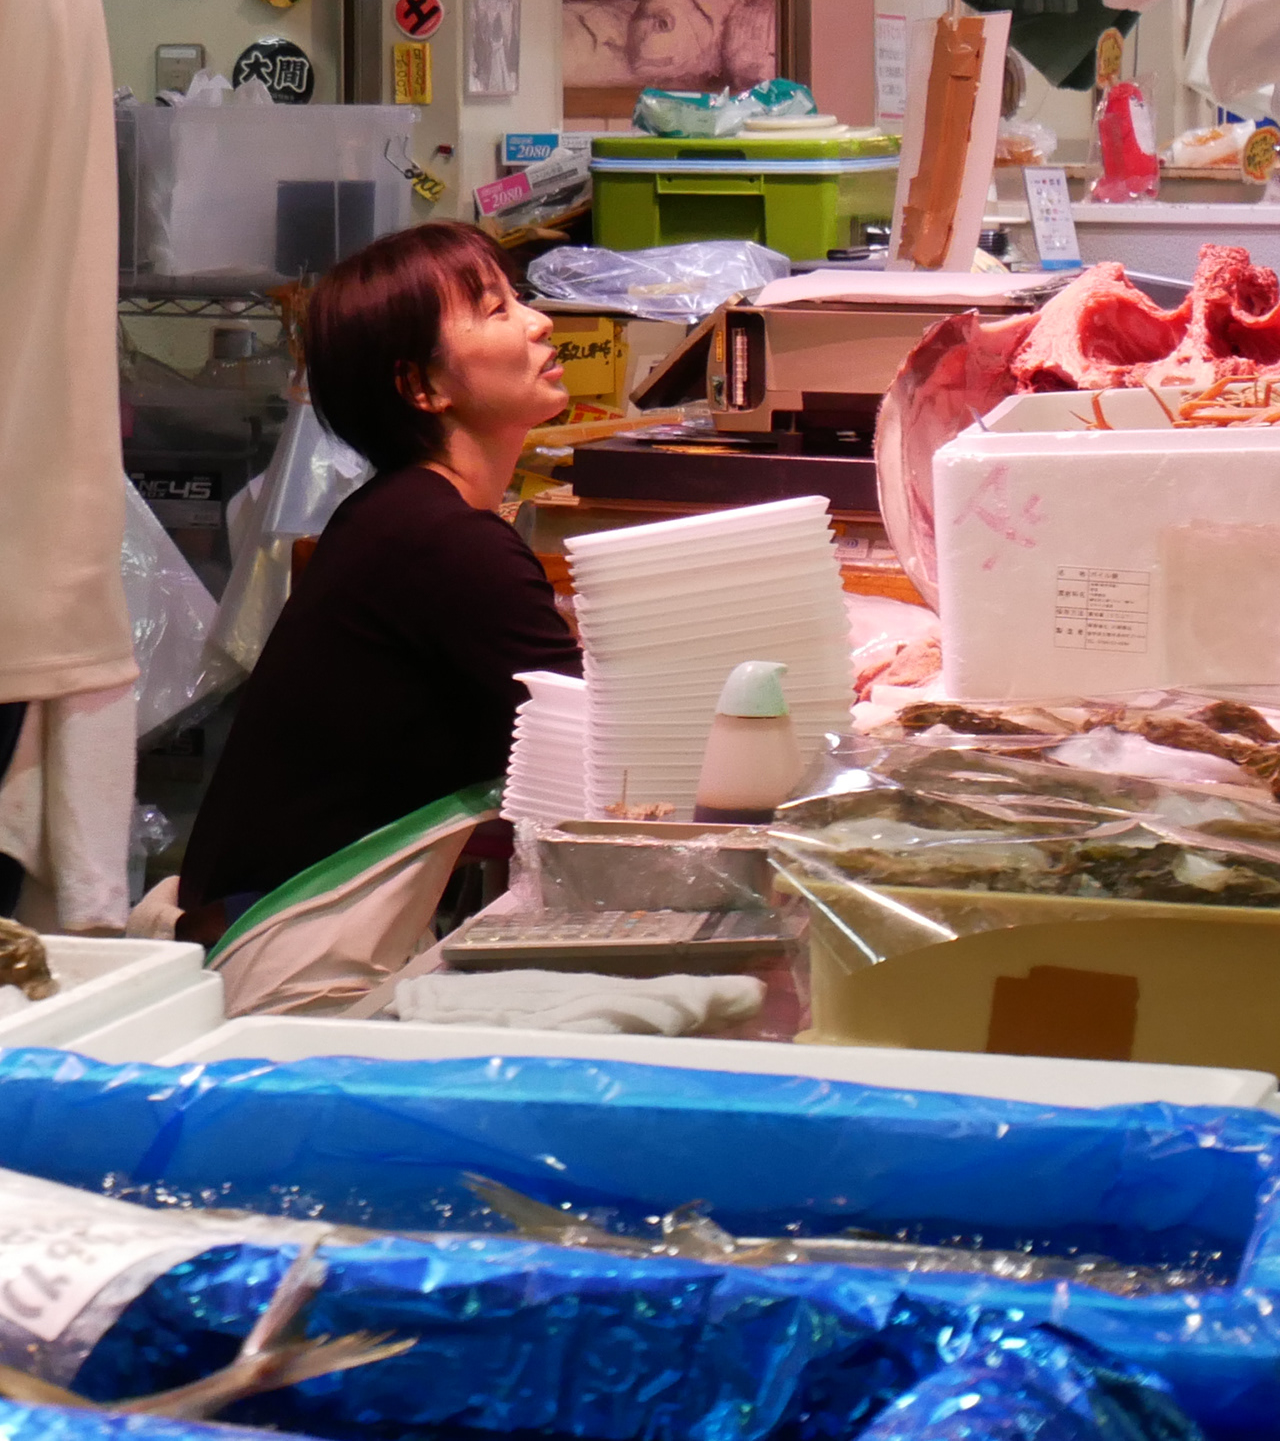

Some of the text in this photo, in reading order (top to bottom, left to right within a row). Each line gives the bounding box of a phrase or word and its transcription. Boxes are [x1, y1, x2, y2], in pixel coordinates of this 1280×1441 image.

[239, 50, 310, 93] 大間
[516, 144, 551, 159] 2080
[491, 186, 524, 209] 2080
